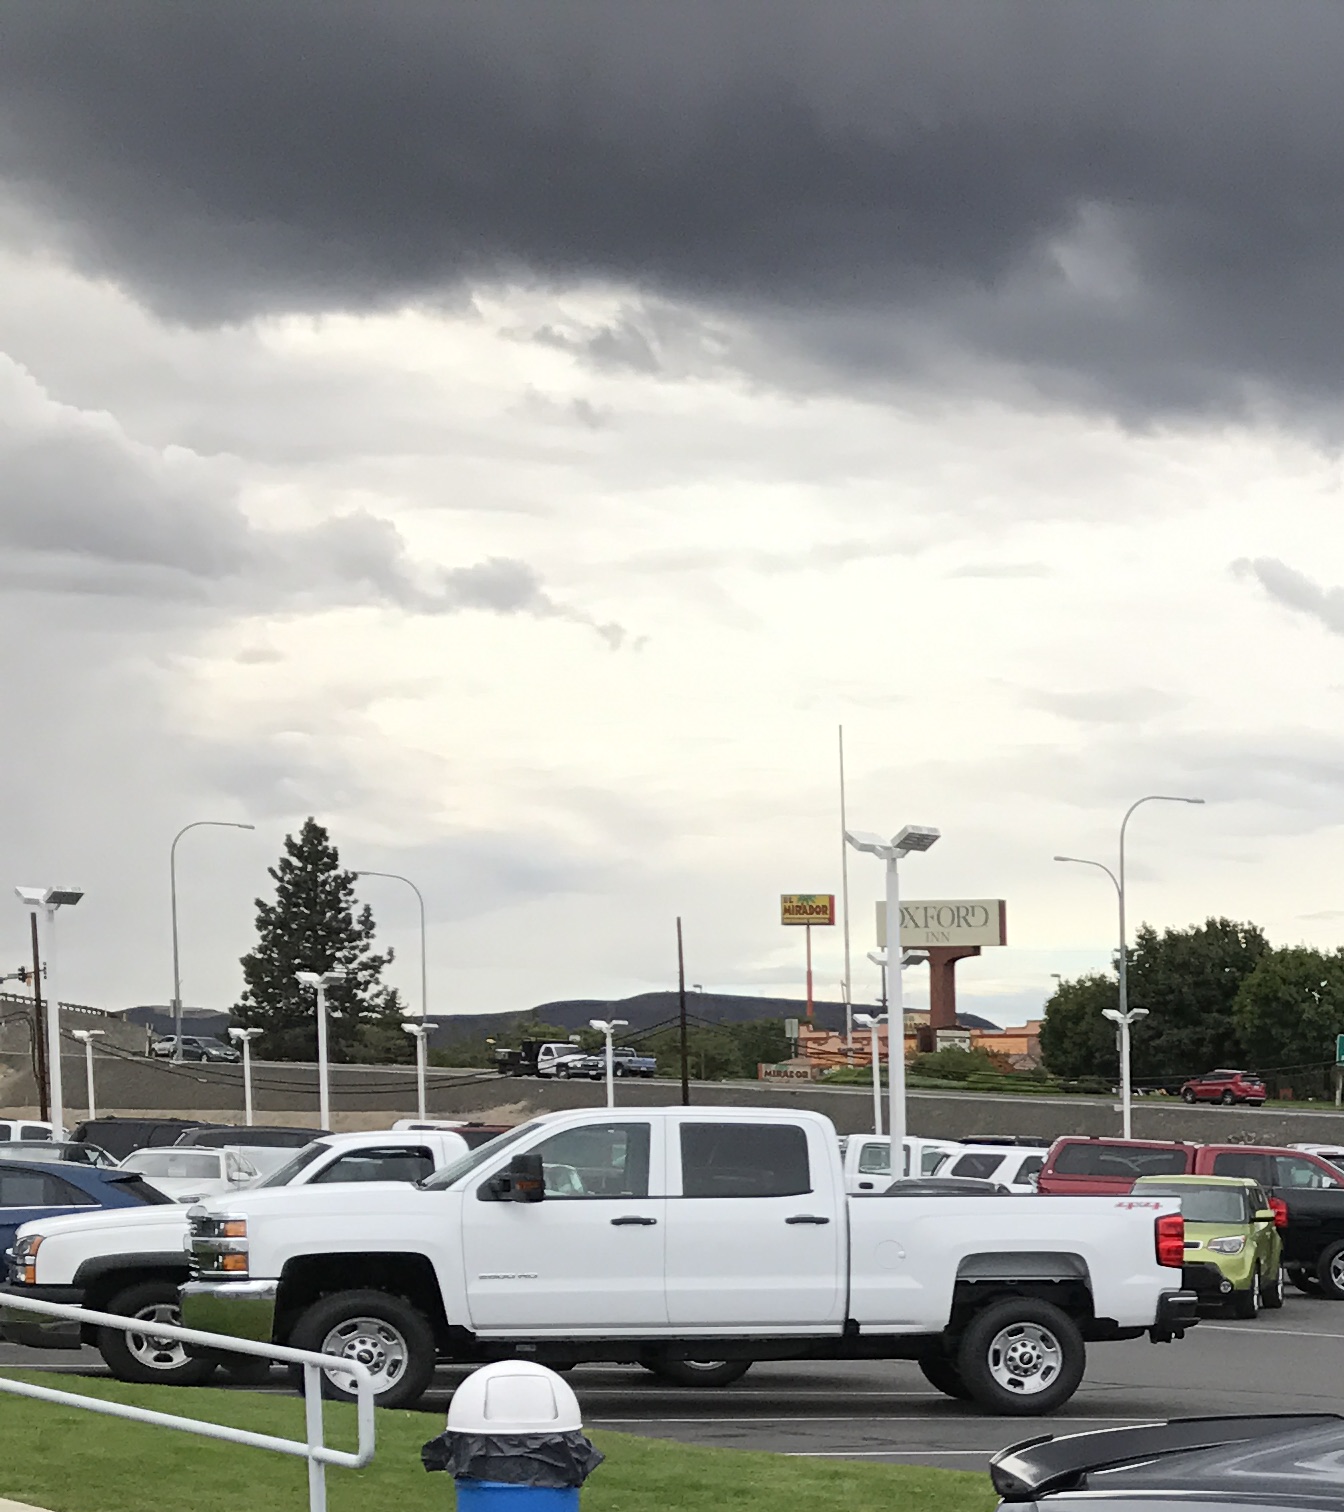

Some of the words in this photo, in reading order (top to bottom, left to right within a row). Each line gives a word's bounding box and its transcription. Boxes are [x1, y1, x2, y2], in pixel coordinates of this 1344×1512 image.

[783, 903, 829, 916] MIRADOR
[925, 931, 950, 943] INN
[764, 1070, 809, 1079] MIRADOR
